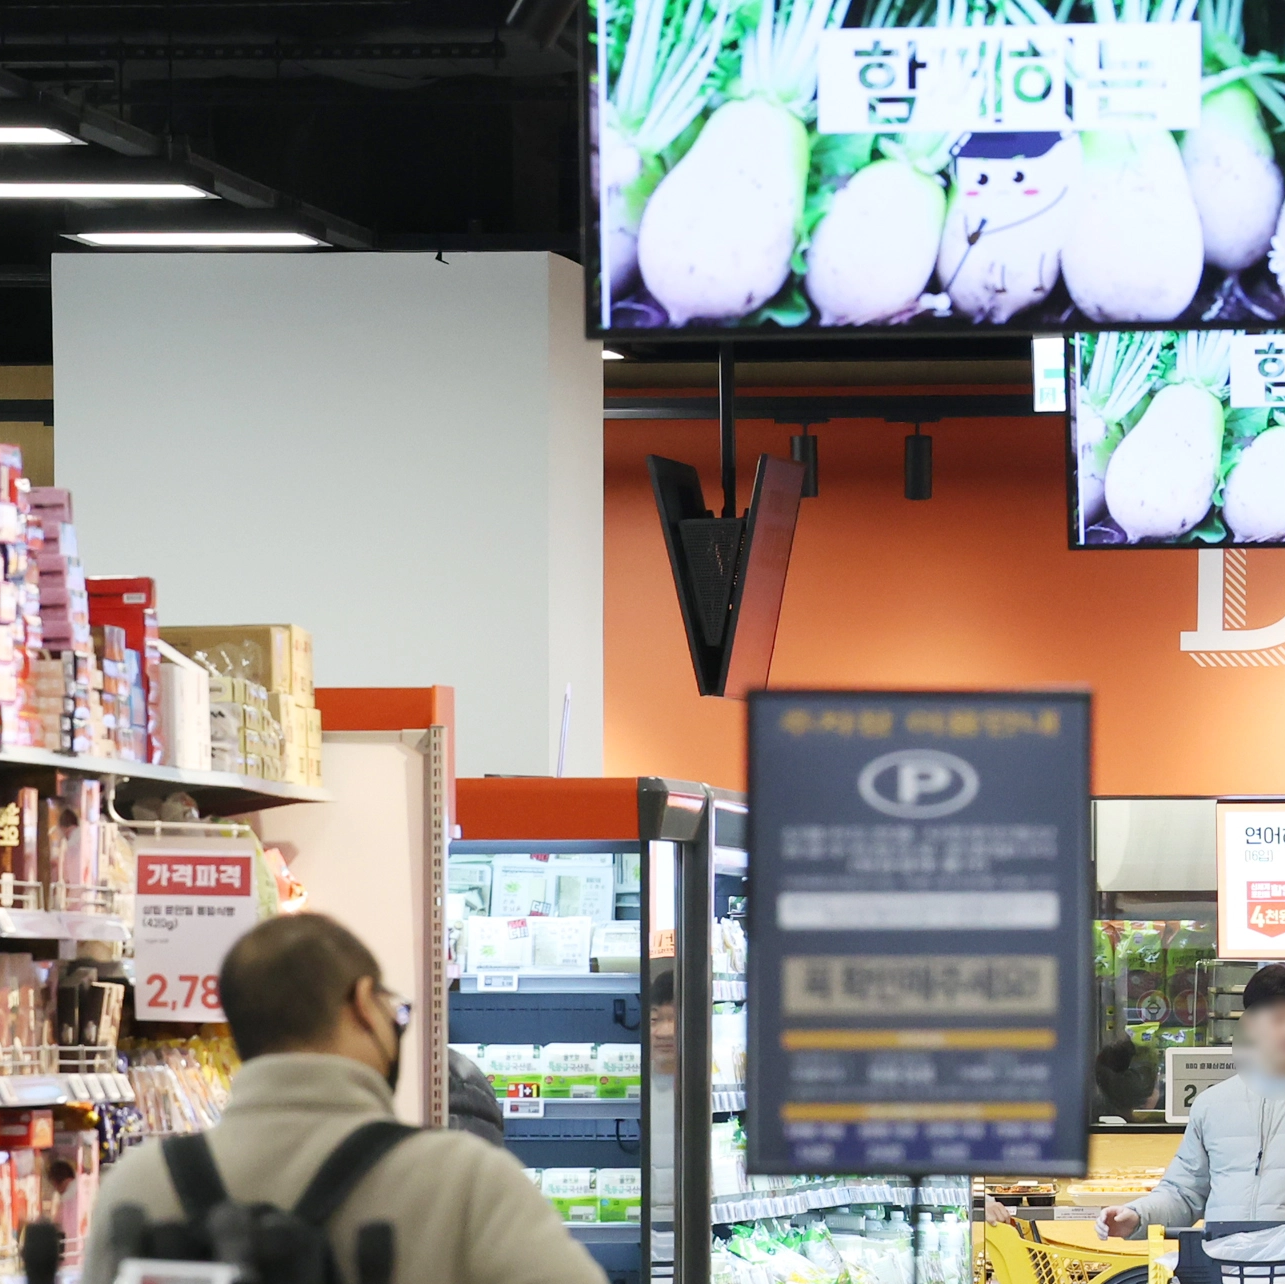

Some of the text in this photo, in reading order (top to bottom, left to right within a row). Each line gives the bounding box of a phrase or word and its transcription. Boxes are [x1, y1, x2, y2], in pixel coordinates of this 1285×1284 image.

[854, 39, 1166, 124] 함께하는
[896, 762, 953, 803] P
[146, 863, 242, 888] 가격파격
[603, 1061, 641, 1073] 특등급국산
[517, 1083, 539, 1098] 1+1
[604, 1183, 641, 1194] 특등급국산
